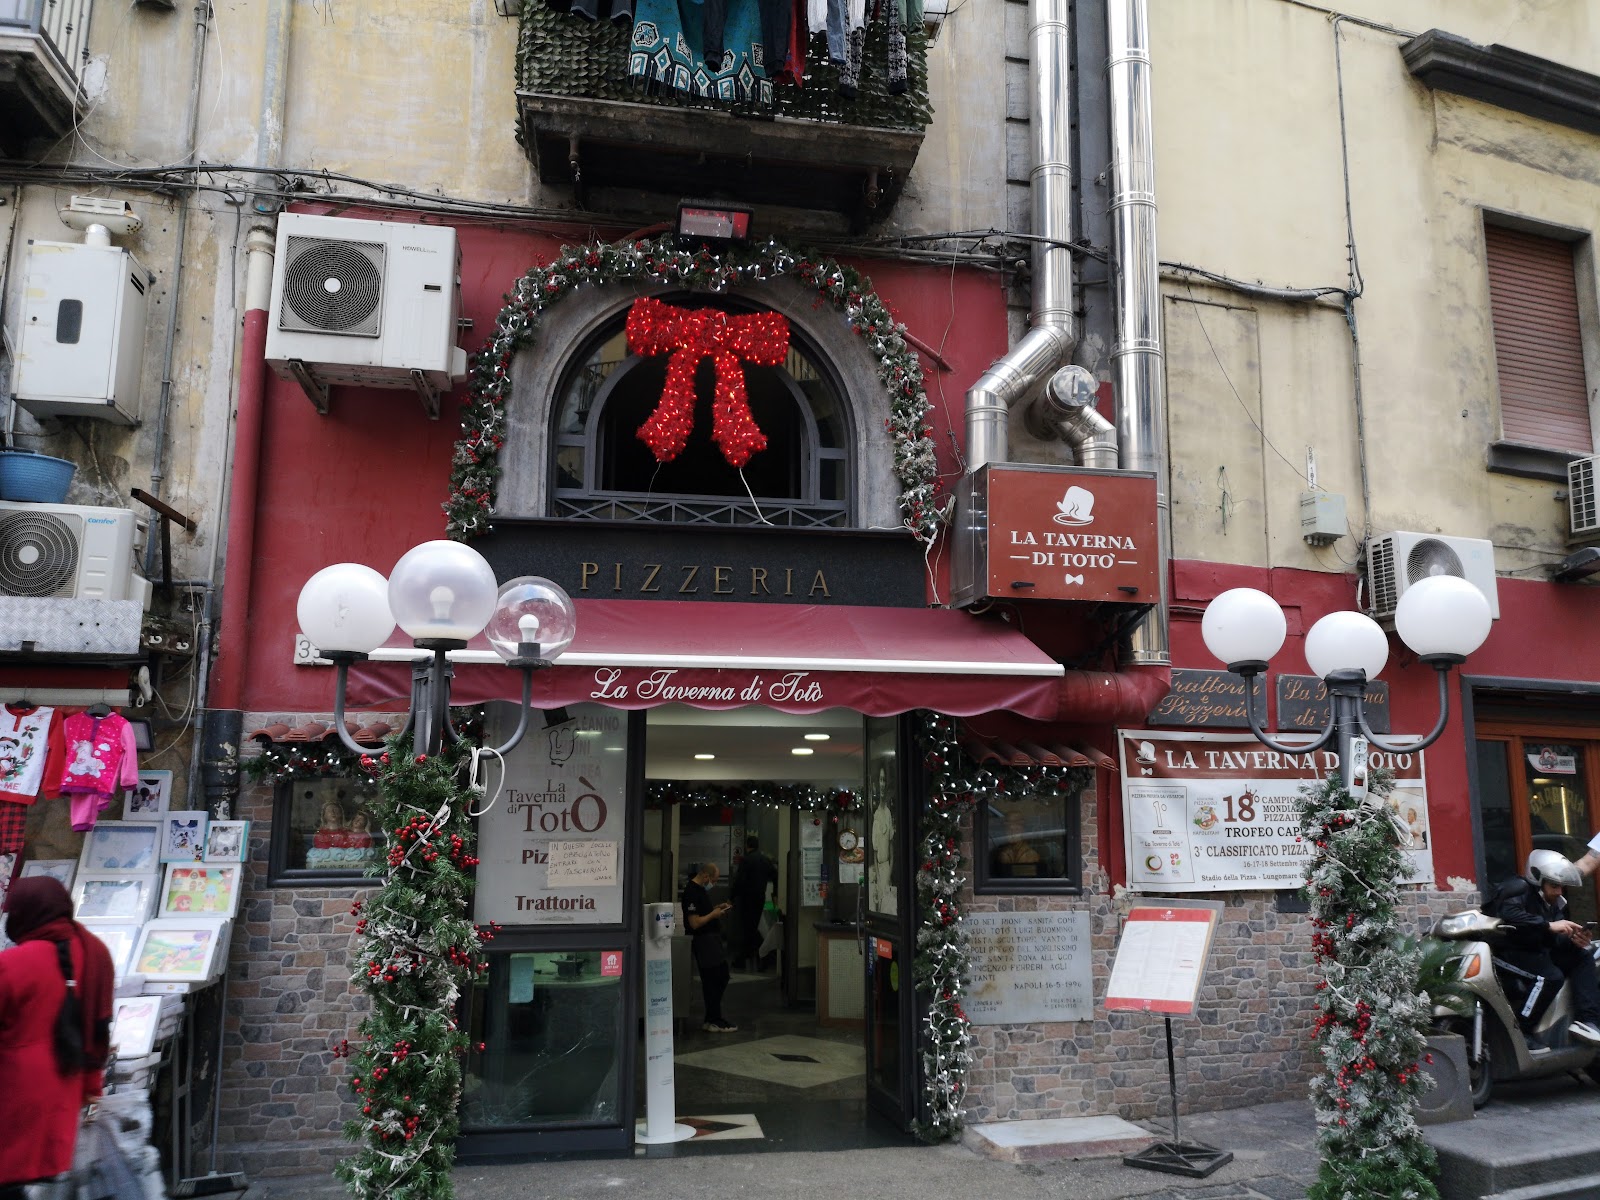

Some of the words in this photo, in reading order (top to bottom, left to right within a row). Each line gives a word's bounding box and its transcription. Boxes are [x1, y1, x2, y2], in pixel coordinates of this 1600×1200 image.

[1010, 530, 1038, 545] LA
[1043, 532, 1137, 550] TAVERNA
[1032, 552, 1055, 566] DI
[1061, 553, 1116, 569] TOTÒ
[580, 562, 831, 597] PIZZERIA
[590, 667, 629, 699] La
[636, 669, 736, 700] Taverna
[740, 675, 763, 701] di
[769, 672, 823, 702] Totò
[1171, 672, 1260, 696] rattori
[1285, 679, 1310, 700] La
[1201, 695, 1209, 704] e
[1158, 695, 1257, 723] Pizzeri
[1295, 708, 1316, 726] di
[1165, 750, 1199, 769] LA
[1205, 751, 1318, 769] TAVERNA
[1323, 751, 1340, 770] D
[546, 779, 566, 793] La
[506, 789, 566, 803] Taverna
[507, 805, 517, 814] di
[1264, 814, 1303, 822] PIZZAIU
[1225, 827, 1273, 838] TROFEO
[1277, 827, 1303, 837] CAP
[551, 842, 559, 850] IN
[563, 842, 585, 850] QUESTO
[1206, 845, 1278, 857] CLASSIFICATO
[1282, 844, 1309, 855] PIZZA
[1263, 873, 1297, 881] Lungomare
[515, 895, 595, 910] Trattoria
[974, 964, 1007, 972] INCENZO
